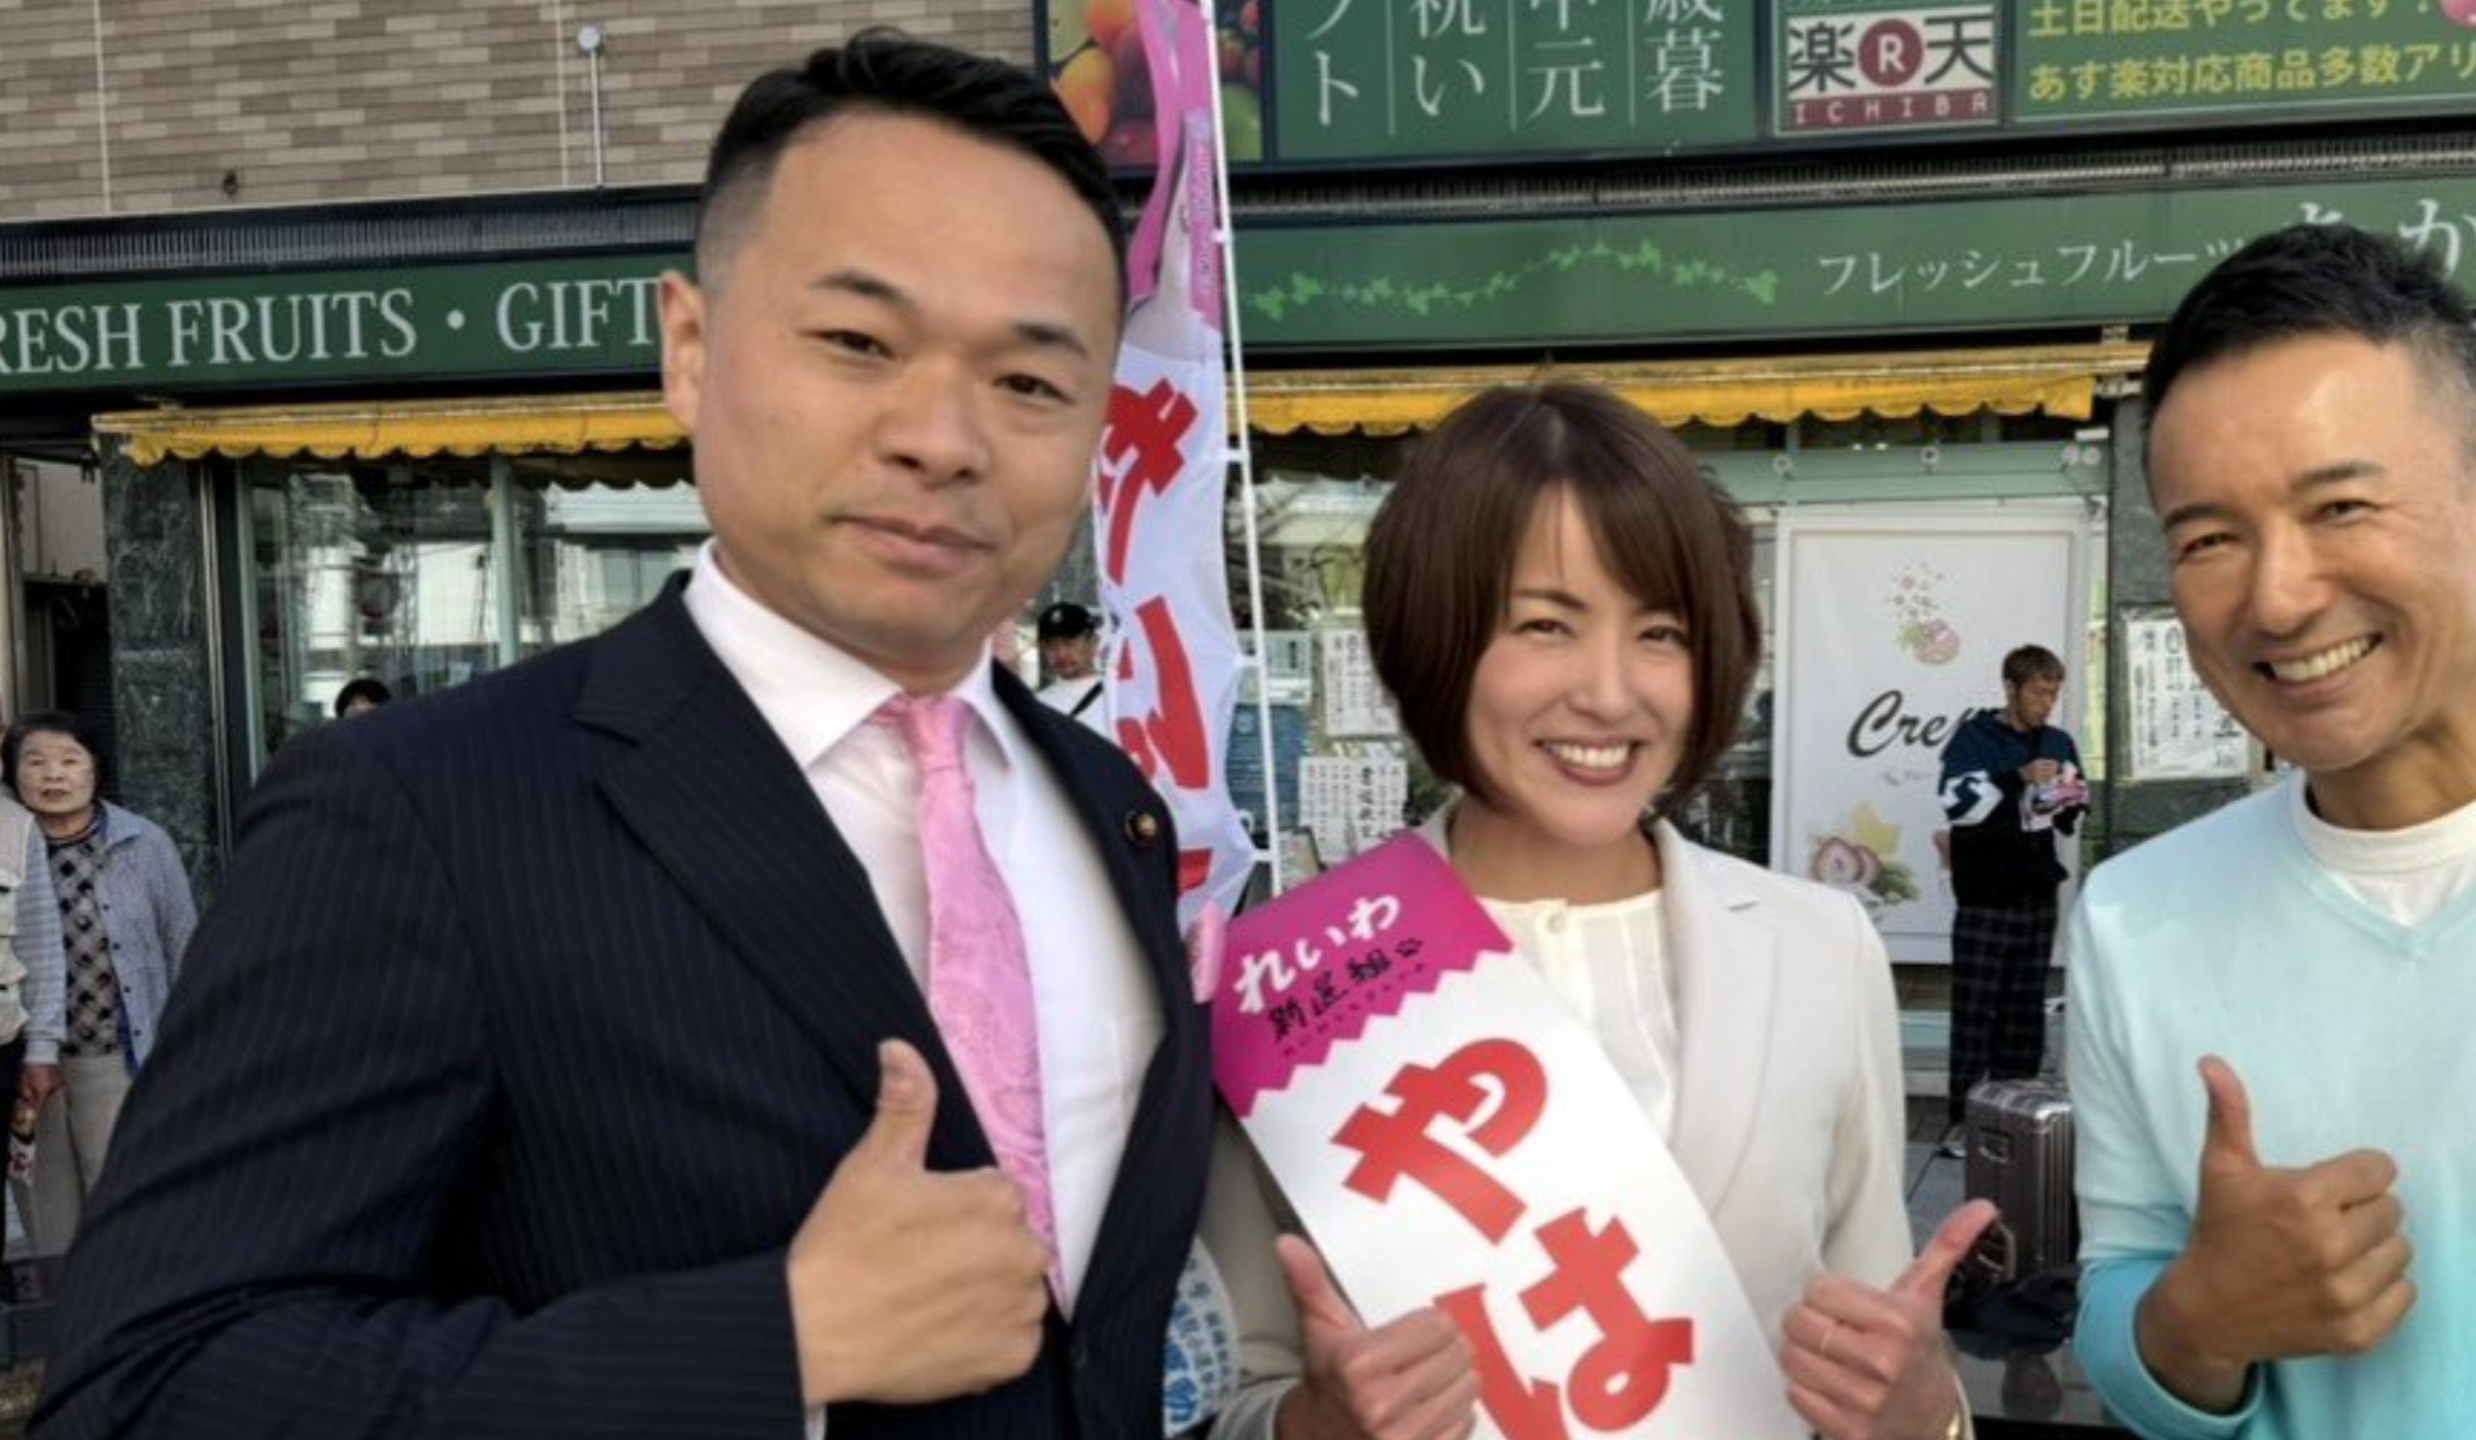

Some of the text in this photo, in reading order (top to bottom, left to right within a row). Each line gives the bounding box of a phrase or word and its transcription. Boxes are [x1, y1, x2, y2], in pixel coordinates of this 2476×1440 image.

[166, 287, 418, 368] FRUITS
[1847, 689, 1975, 758] Cre
[1234, 894, 1401, 1014] れいわ
